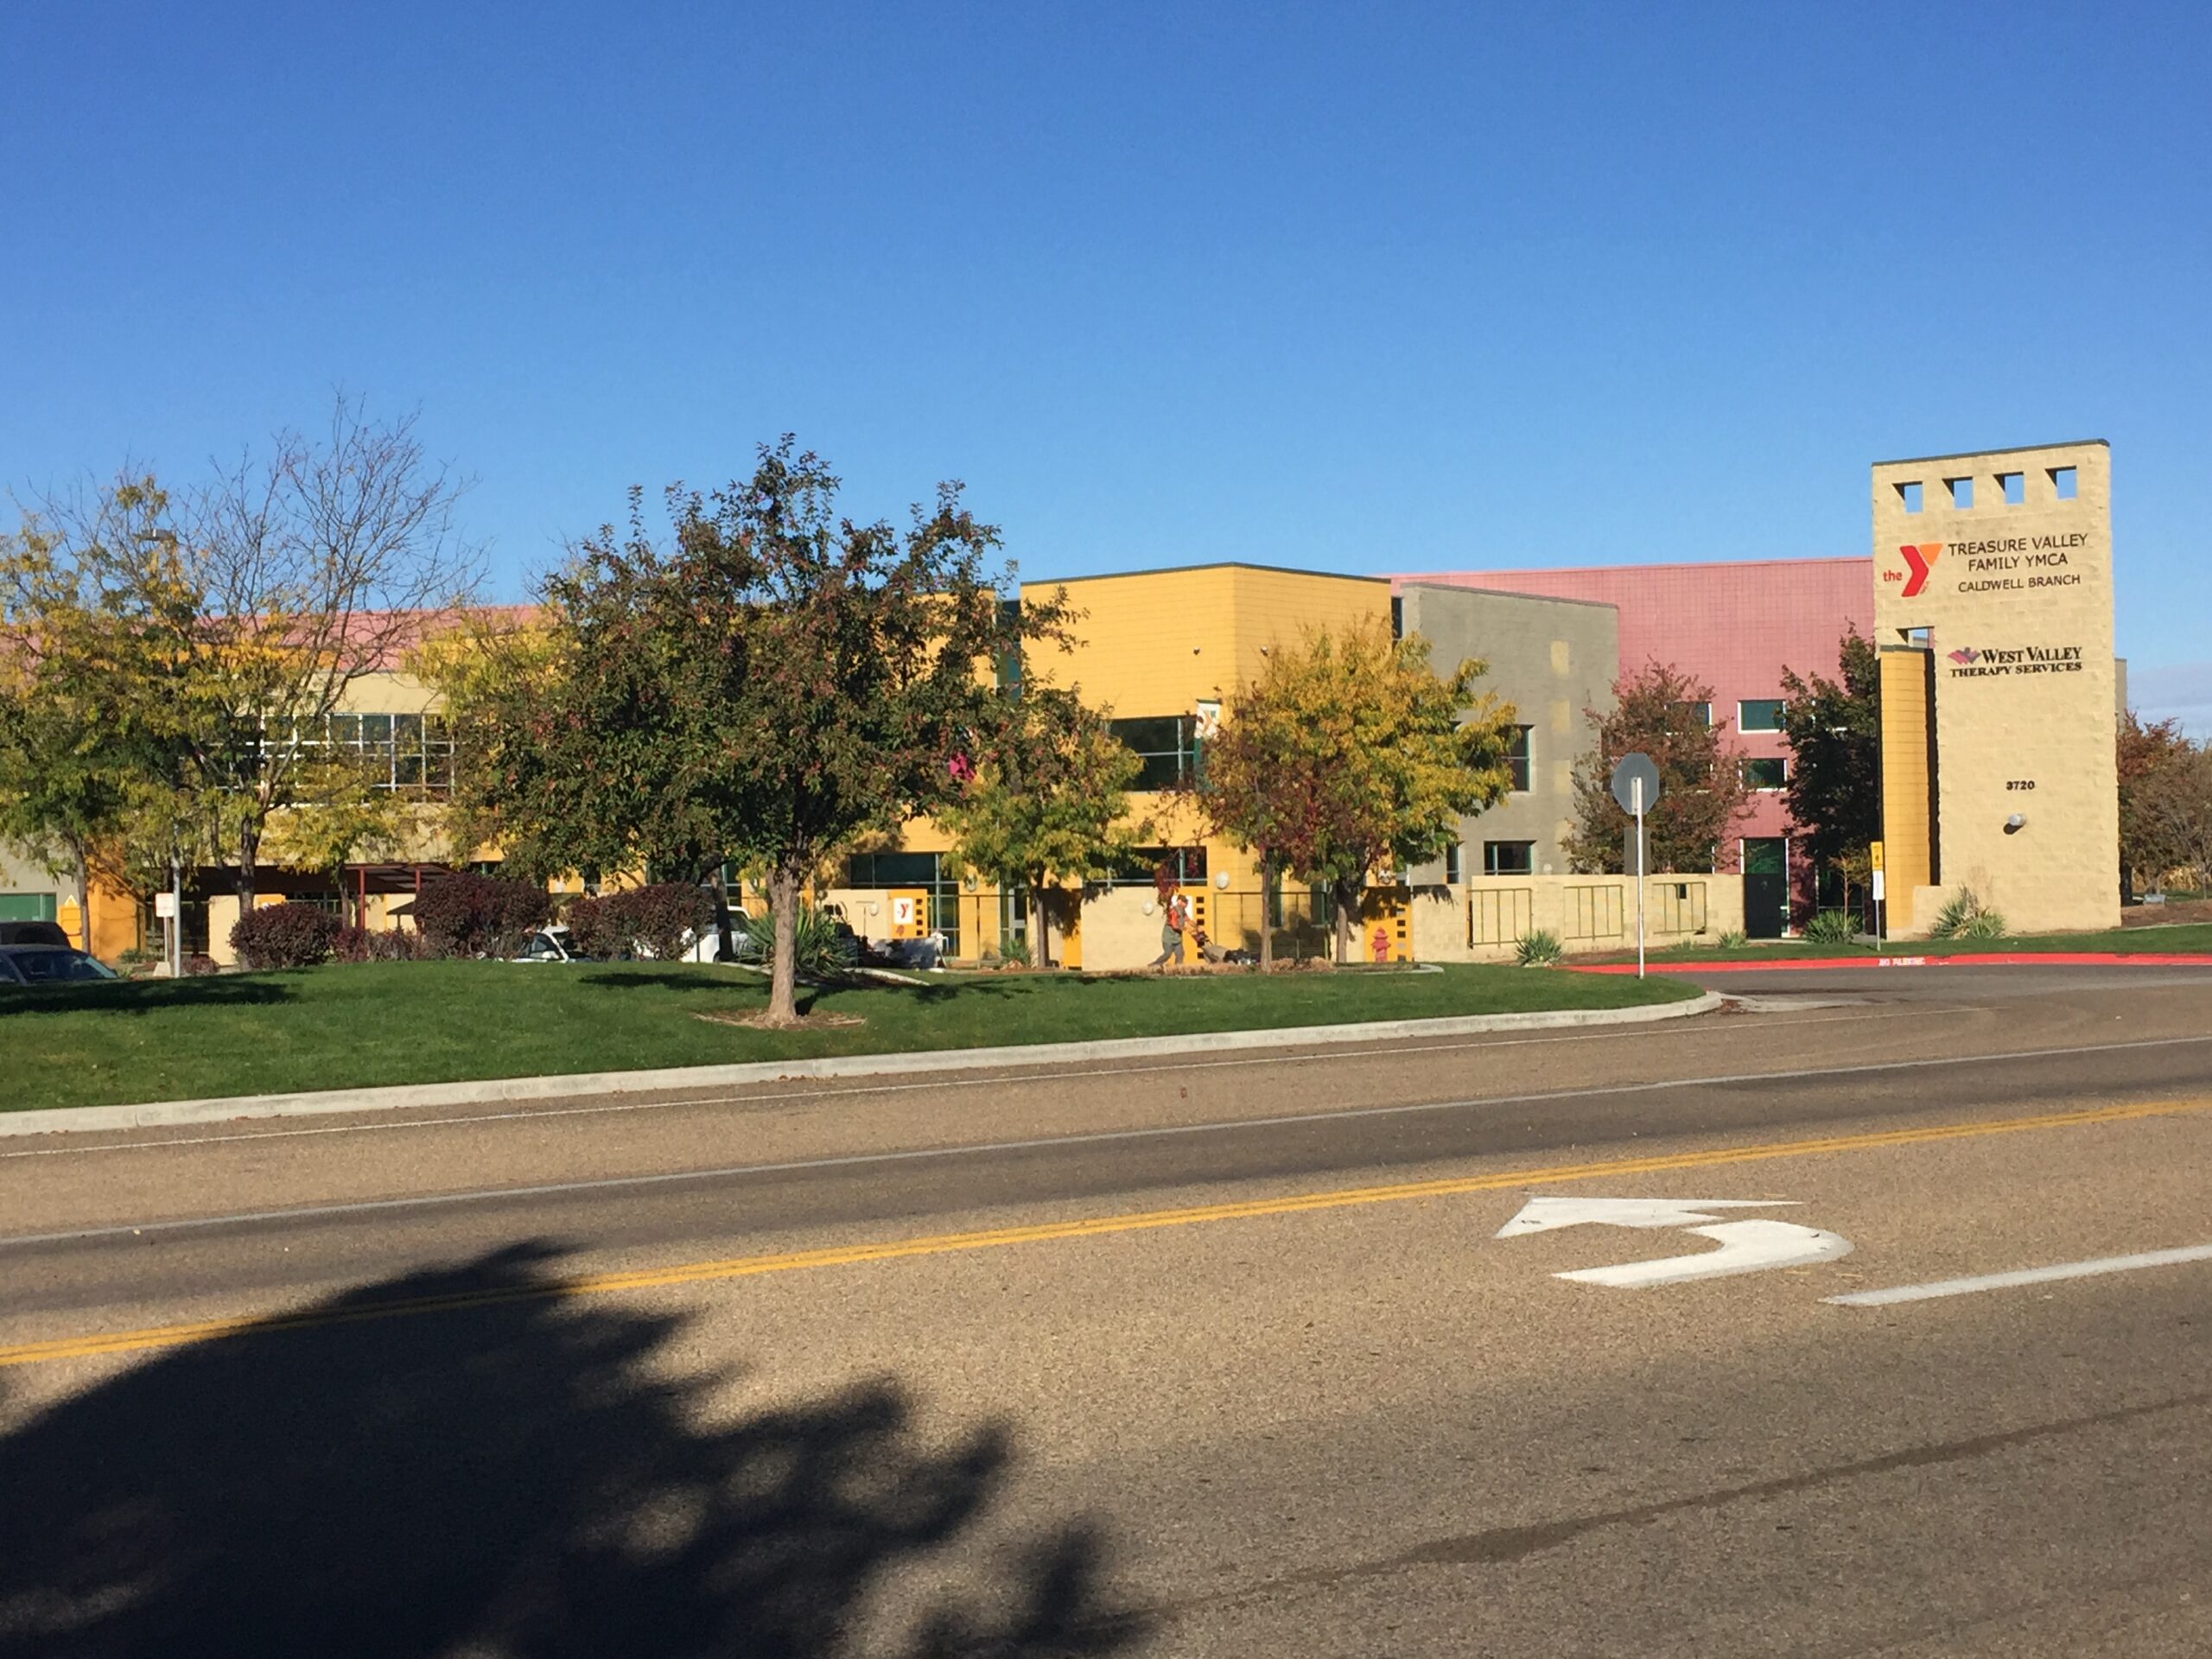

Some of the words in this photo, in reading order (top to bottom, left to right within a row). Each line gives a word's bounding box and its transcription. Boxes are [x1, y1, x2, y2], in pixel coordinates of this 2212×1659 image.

[1948, 537, 2027, 556] TREASURE
[2031, 533, 2088, 550] VALLEY
[1968, 556, 2020, 572] FAMILY
[2025, 552, 2068, 568] YMCA
[1883, 569, 1903, 582] the
[1958, 578, 2024, 593] CALDWELL
[2028, 575, 2081, 588] BRANCH
[1981, 649, 2024, 664] WEST
[2026, 646, 2082, 661] VALLEY
[1950, 665, 2012, 677] THERAPY
[2015, 662, 2082, 674] SERVICES
[2005, 780, 2035, 791] 3720
